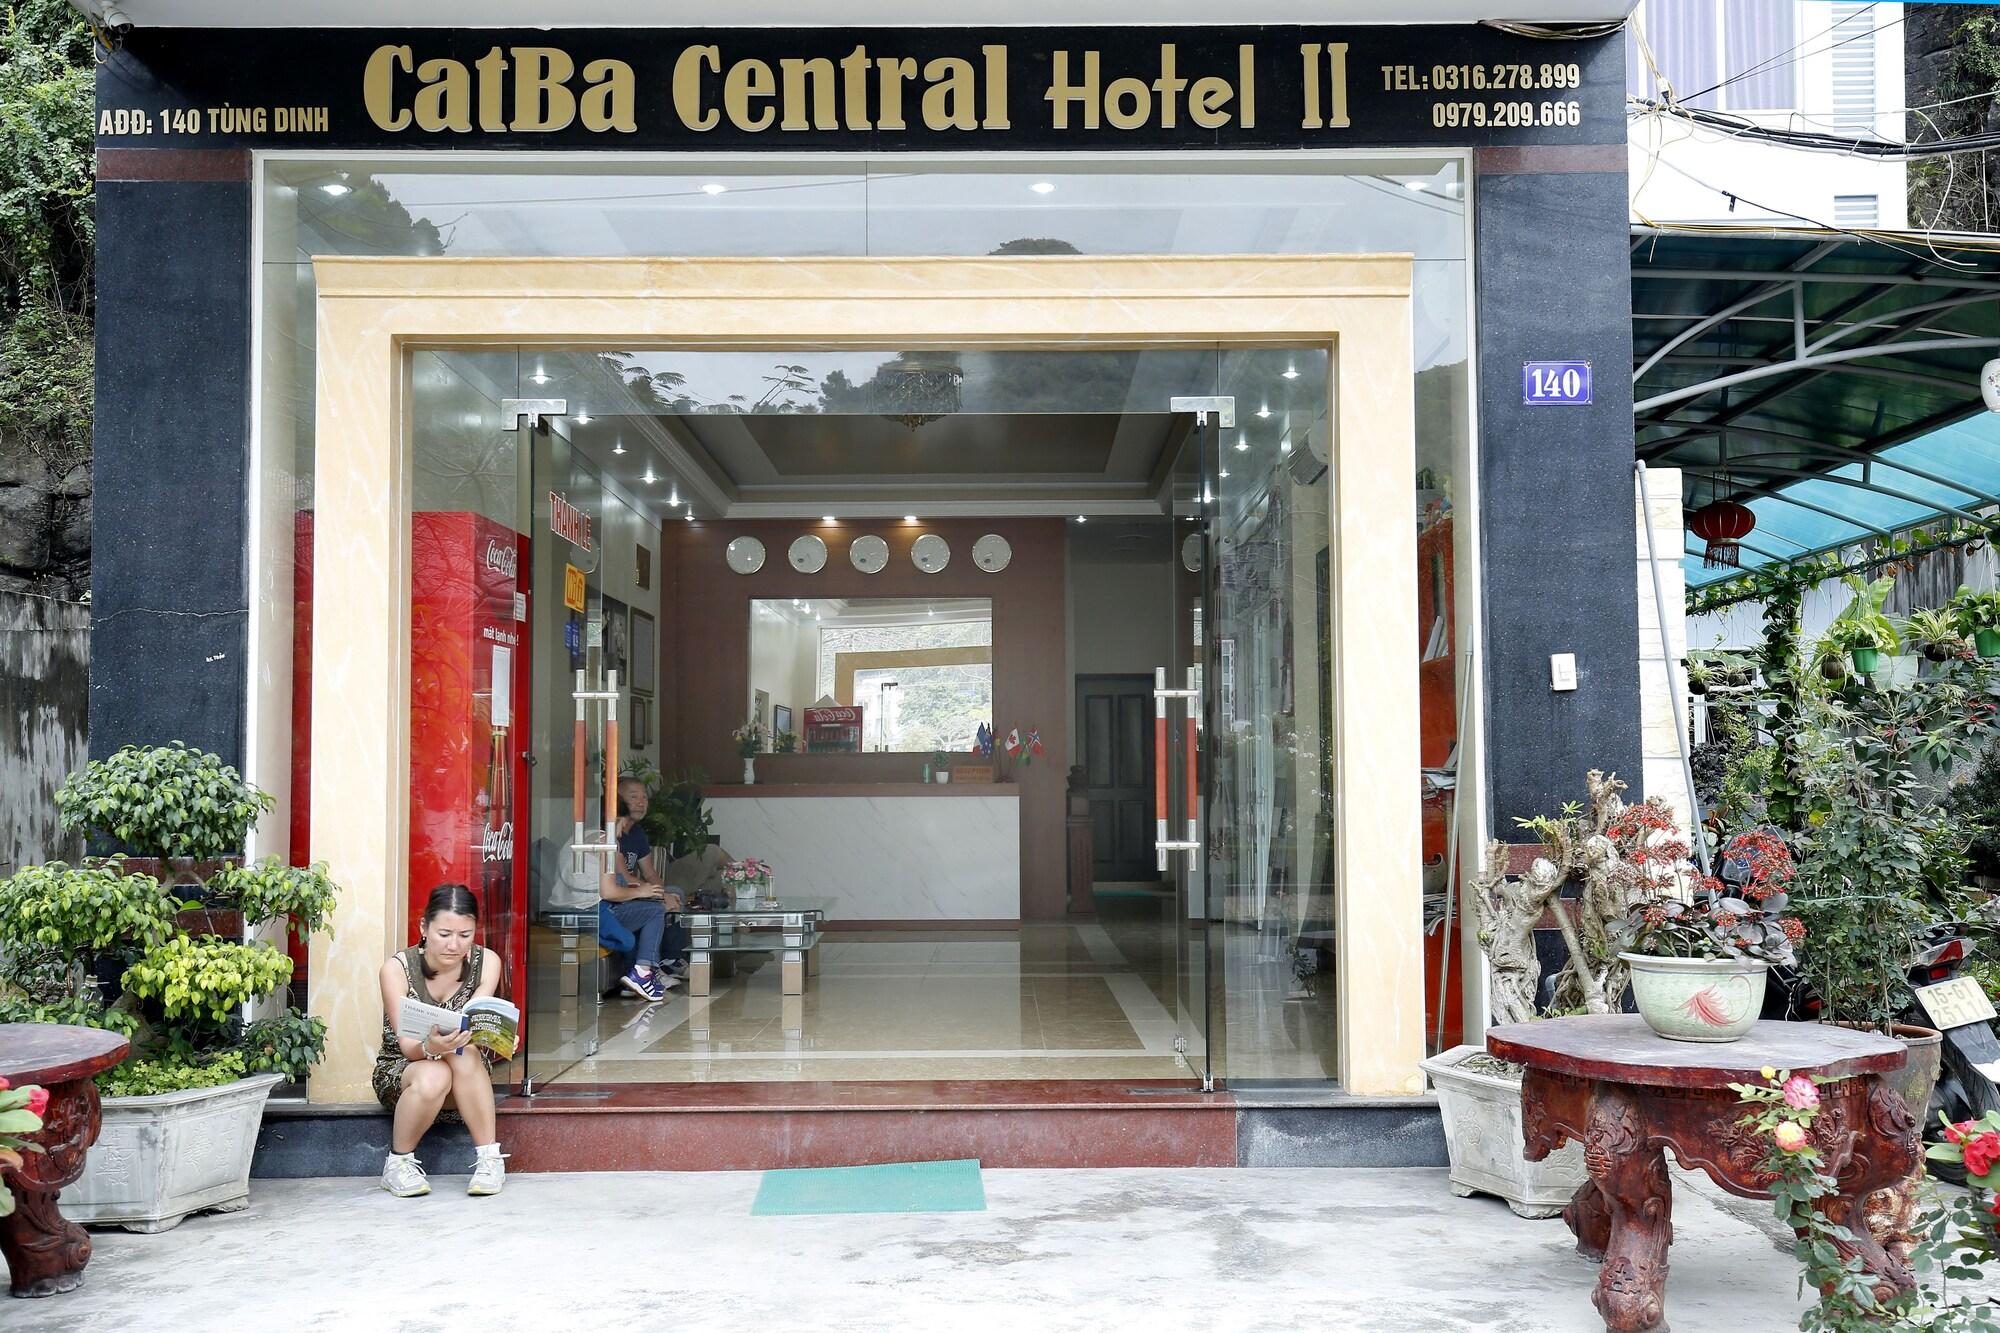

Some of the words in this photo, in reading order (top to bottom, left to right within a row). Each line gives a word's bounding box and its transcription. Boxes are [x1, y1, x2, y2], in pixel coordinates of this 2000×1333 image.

[363, 44, 638, 133] CatBa
[672, 44, 1011, 132] Central
[1043, 43, 1255, 131] Hotel
[1300, 42, 1351, 129] II
[1381, 64, 1429, 91] TEL:
[1432, 63, 1580, 90] 0316.278.899
[159, 108, 201, 134] 140
[207, 102, 267, 133] TÙNG
[274, 106, 329, 133] DINH
[1432, 100, 1581, 128] 0979.209.666
[1531, 368, 1581, 398] 140
[1927, 981, 1975, 1006] 15-G1
